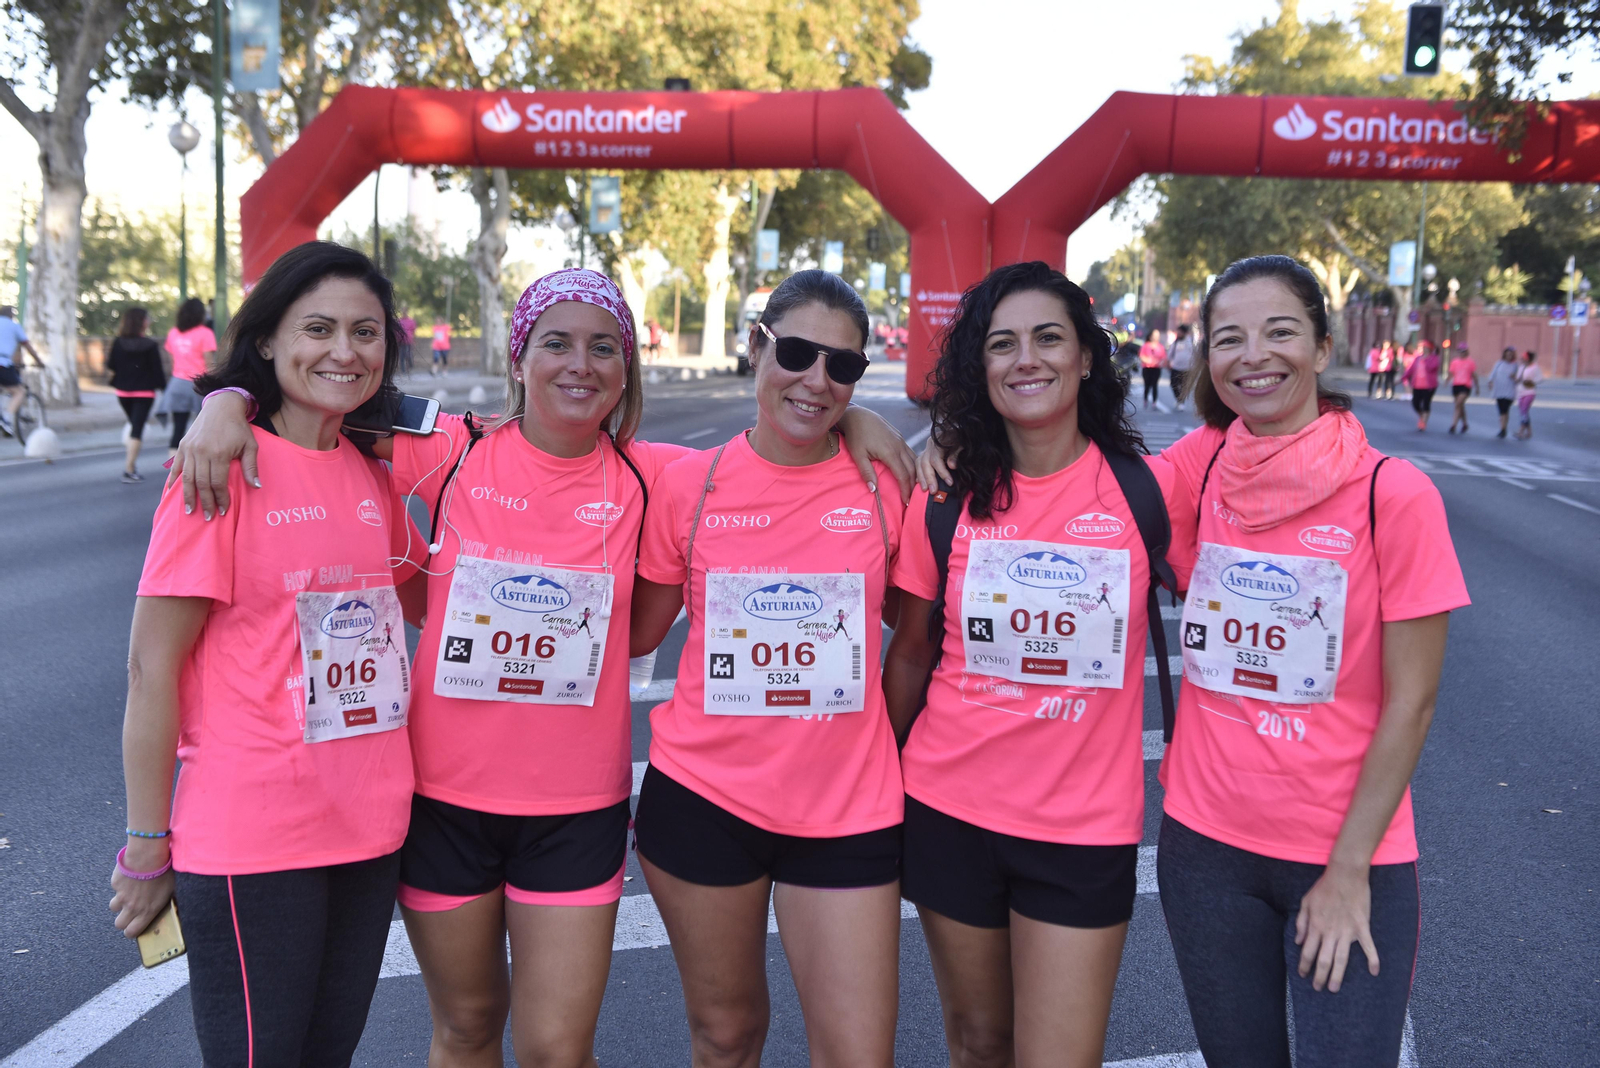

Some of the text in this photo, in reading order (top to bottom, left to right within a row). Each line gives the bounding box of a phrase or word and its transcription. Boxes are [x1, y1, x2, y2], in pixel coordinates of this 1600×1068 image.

[525, 103, 687, 133] Santander
[471, 486, 528, 511] OYSHO
[266, 505, 327, 527] OYSHO
[705, 515, 771, 528] OYSHO
[955, 524, 1018, 540] OYSHO
[1070, 522, 1121, 533] ASTURIANA
[1013, 563, 1080, 581] ASTURIANA
[1226, 571, 1293, 594] ASTURIANA
[496, 585, 564, 606] ASTURIANA
[749, 597, 817, 611] ASTURIANA
[325, 616, 373, 631] ASTURIANA
[542, 614, 572, 625] Carrera
[797, 619, 828, 629] Carrera
[1010, 608, 1077, 637] 016
[558, 625, 580, 639] Mujer
[816, 630, 837, 643] Mujer
[1223, 618, 1287, 651] 016
[491, 631, 557, 659] 016
[1024, 641, 1059, 654] 5325
[751, 642, 816, 667] 016
[973, 654, 1010, 666] OYSHO
[1236, 651, 1268, 668] 5323
[326, 658, 377, 688] 016
[503, 662, 536, 674] 5321
[1034, 663, 1062, 671] Santander
[443, 676, 484, 688] OYSHO
[767, 672, 800, 685] 5324
[1245, 676, 1272, 686] Santander
[510, 683, 538, 691] Santander
[1294, 689, 1324, 697] ZURICH
[339, 690, 367, 706] 5322
[712, 693, 750, 703] OYSHO
[1034, 696, 1087, 723] 2019
[308, 717, 332, 730] YSHO
[1257, 711, 1306, 741] 2019
